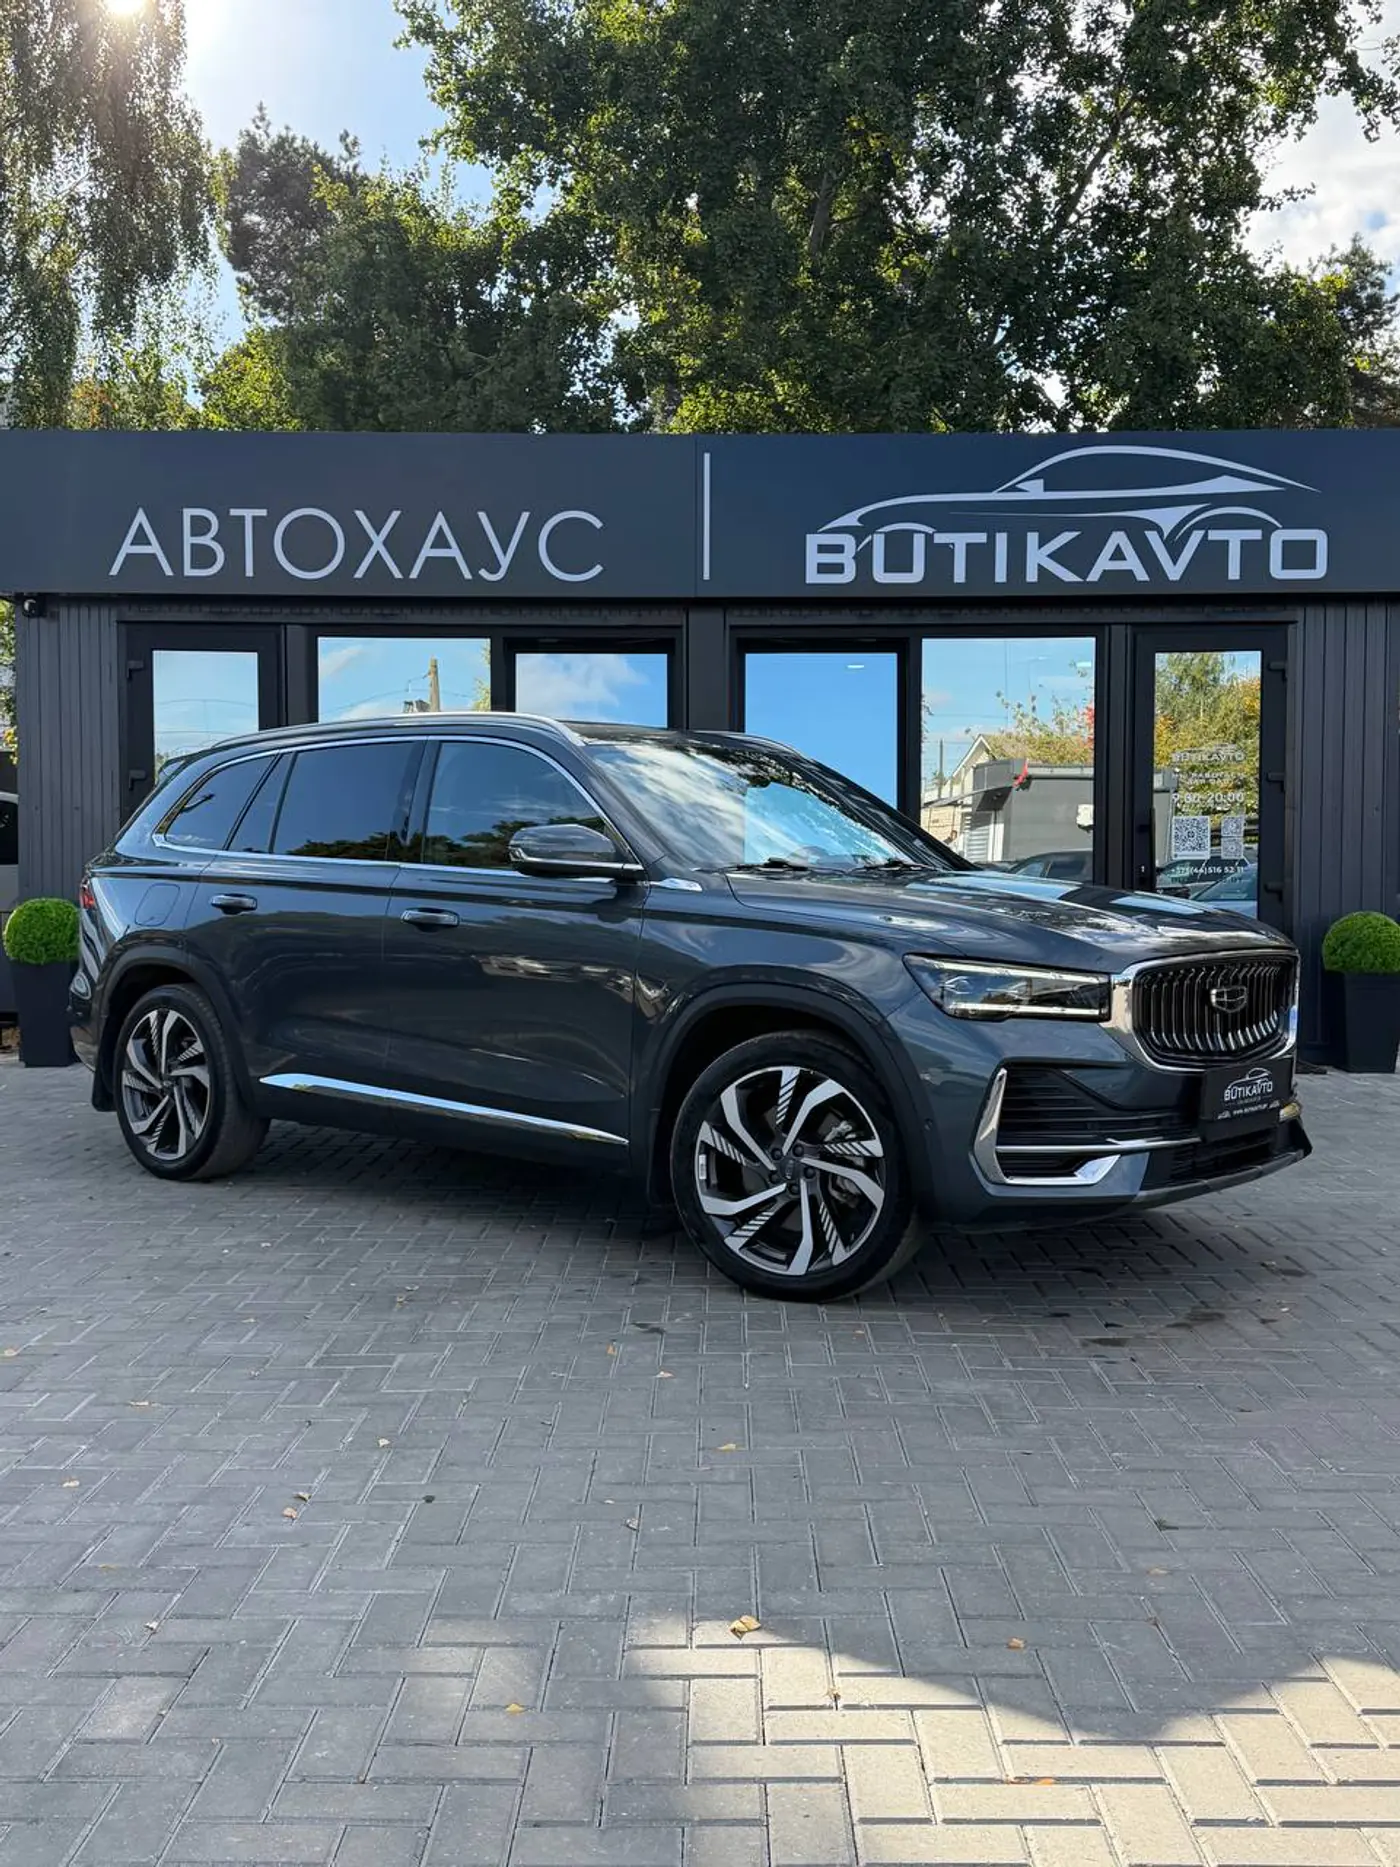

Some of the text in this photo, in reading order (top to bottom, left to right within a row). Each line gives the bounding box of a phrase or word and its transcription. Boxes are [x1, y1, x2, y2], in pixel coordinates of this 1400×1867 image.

[109, 506, 605, 583] АВТОХАУС
[804, 528, 1329, 584] BUTIKAVTO
[1223, 1080, 1274, 1101] BUTIKAVTO
